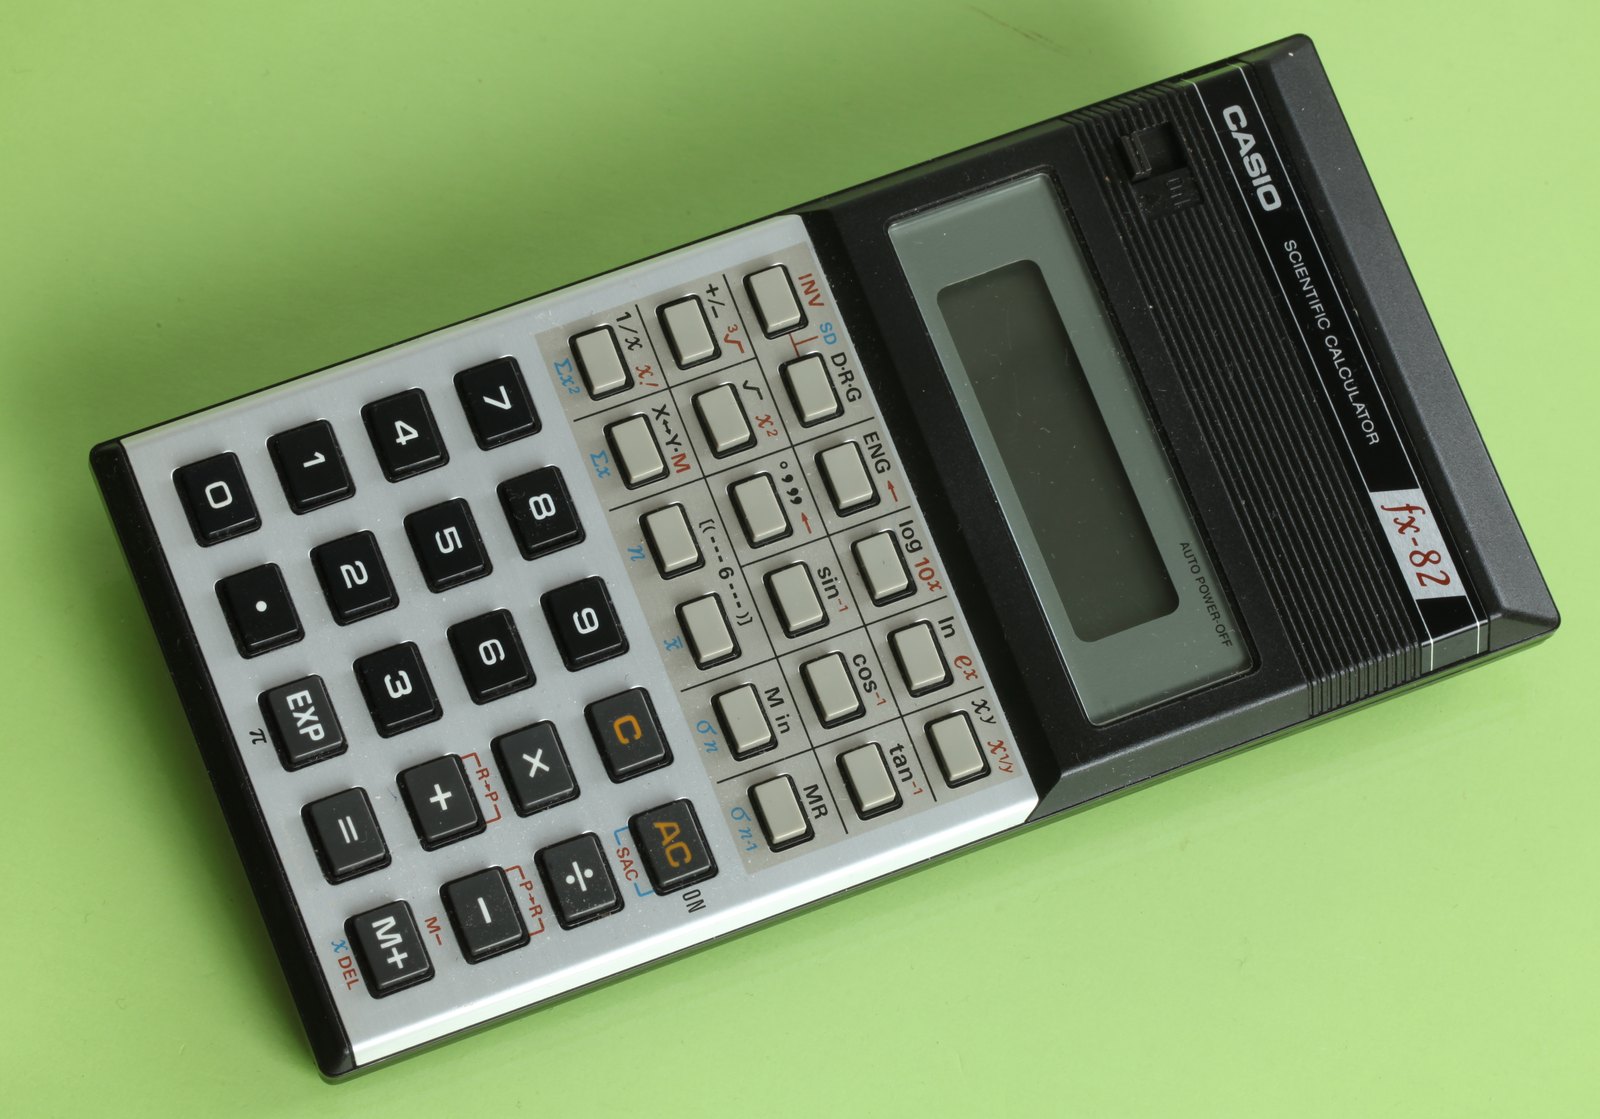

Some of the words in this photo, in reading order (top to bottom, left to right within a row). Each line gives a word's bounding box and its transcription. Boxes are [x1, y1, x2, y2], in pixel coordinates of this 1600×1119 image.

[1222, 104, 1282, 212] CASIO
[798, 273, 824, 308] INV
[616, 312, 643, 351] 1/x
[819, 321, 837, 346] SD
[1284, 239, 1331, 331] SCIENTIFIC
[1324, 335, 1380, 446] CALCULATOR
[482, 385, 513, 410] 7
[395, 420, 419, 446] 4
[303, 451, 326, 468] 1
[863, 431, 891, 475] ENG
[528, 492, 557, 521] 8
[435, 526, 463, 554] 5
[898, 519, 923, 553] log
[1380, 503, 1451, 587] fx-82
[340, 560, 369, 589] 2
[1179, 541, 1200, 575] AUTO
[572, 606, 600, 635] 9
[478, 638, 506, 666] 6
[384, 670, 413, 699] 3
[286, 689, 325, 742] EXP
[613, 715, 642, 742] C
[803, 784, 828, 819] MR
[652, 821, 693, 868] AC
[616, 847, 639, 882] SAC
[682, 889, 706, 914] ON
[371, 916, 408, 969] M+
[338, 955, 360, 990] DEL
